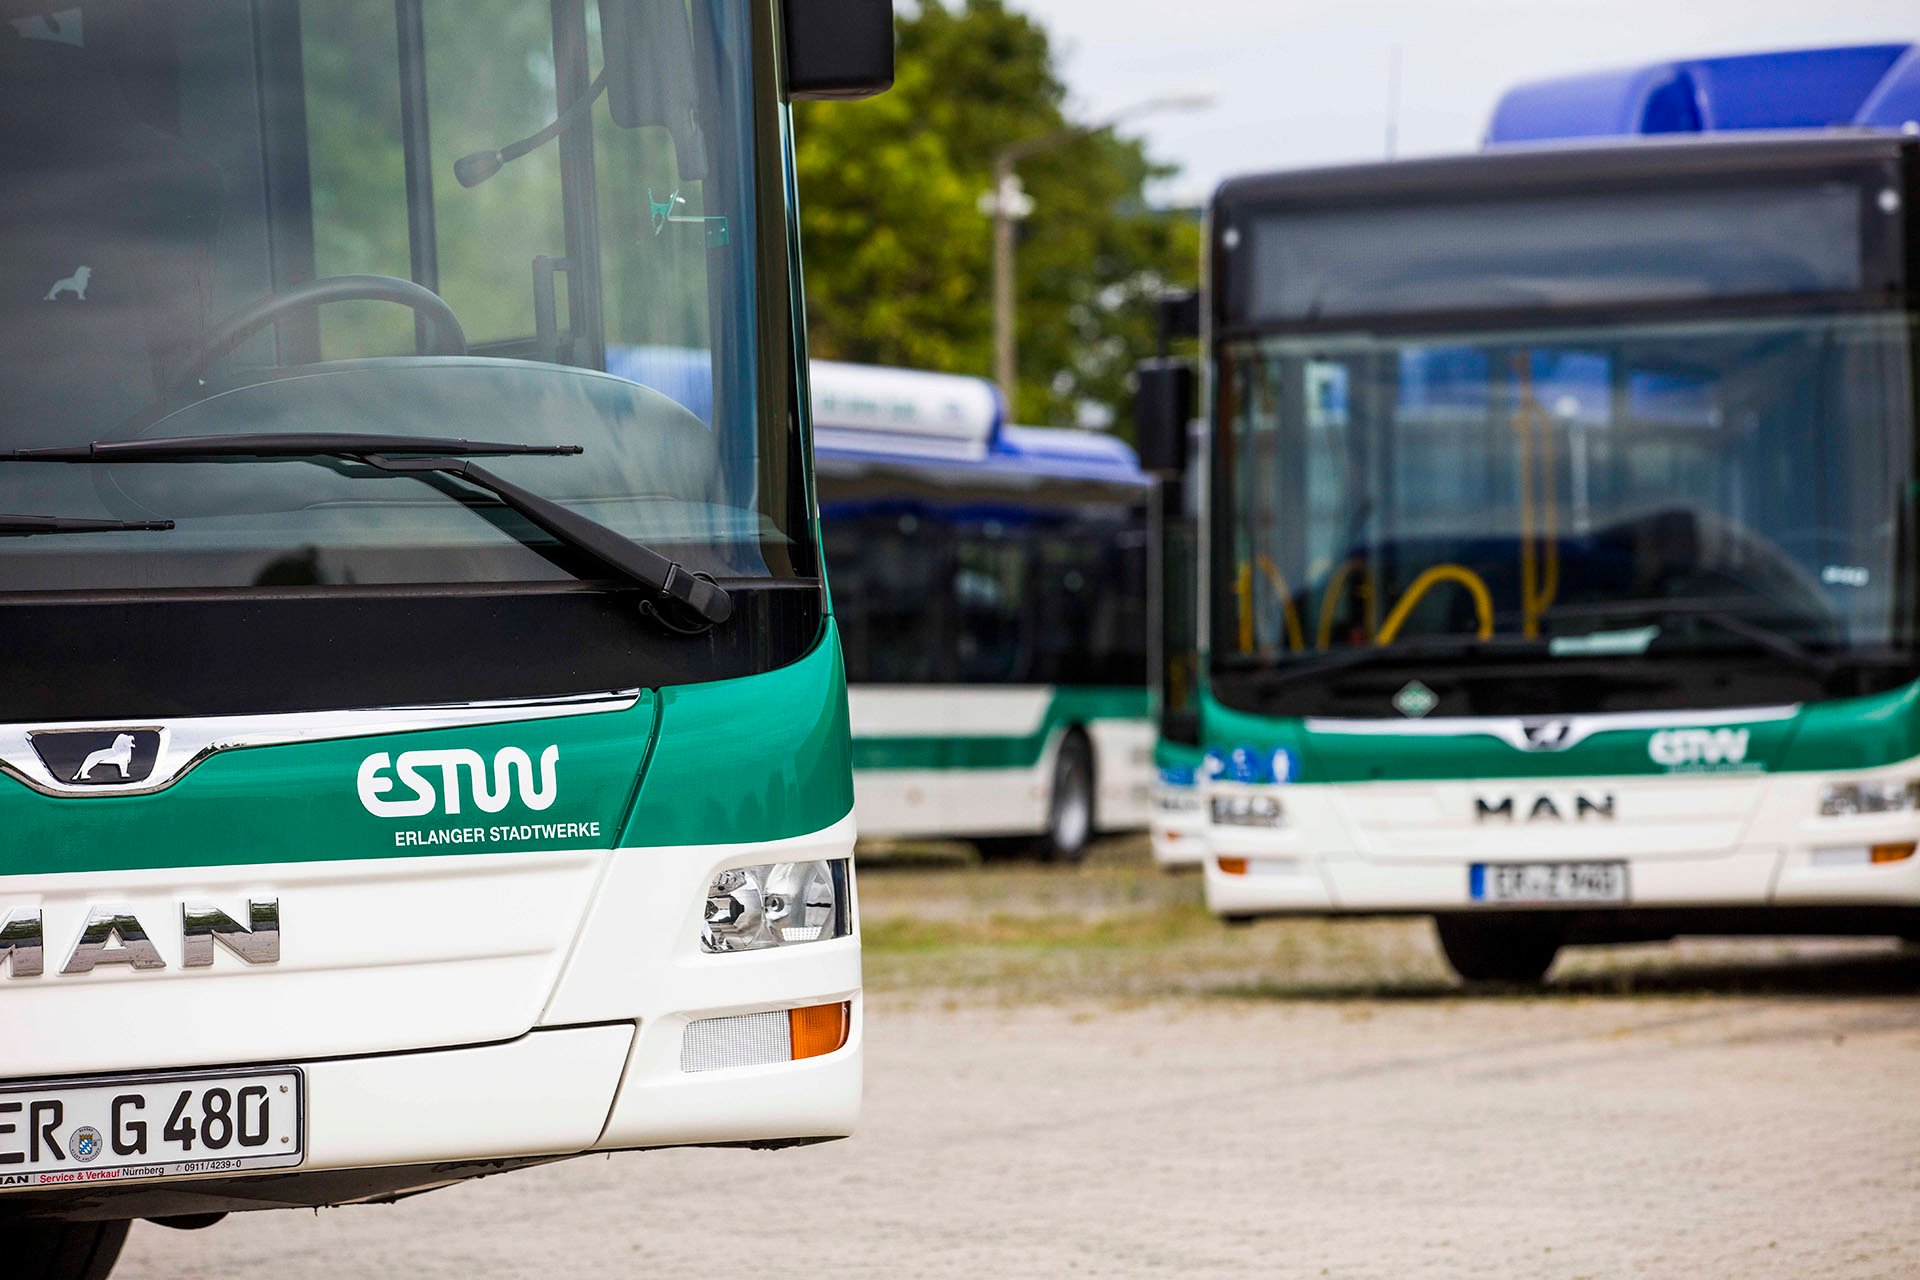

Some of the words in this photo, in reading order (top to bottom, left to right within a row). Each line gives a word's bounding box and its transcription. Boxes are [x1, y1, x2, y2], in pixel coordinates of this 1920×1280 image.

[356, 743, 560, 818] ESTW
[1475, 793, 1615, 823] MAN
[395, 826, 485, 847] ERLANGER
[489, 821, 601, 842] STADTWERKE
[0, 1099, 66, 1164] ER
[111, 1094, 147, 1156] G
[163, 1085, 270, 1151] 480
[0, 1175, 29, 1185] AN
[39, 1173, 75, 1184] Service
[77, 1171, 85, 1181] &
[85, 1169, 121, 1181] Verkauf
[122, 1165, 165, 1177] Nürnberg
[184, 1159, 242, 1173] 0911/4239-0
